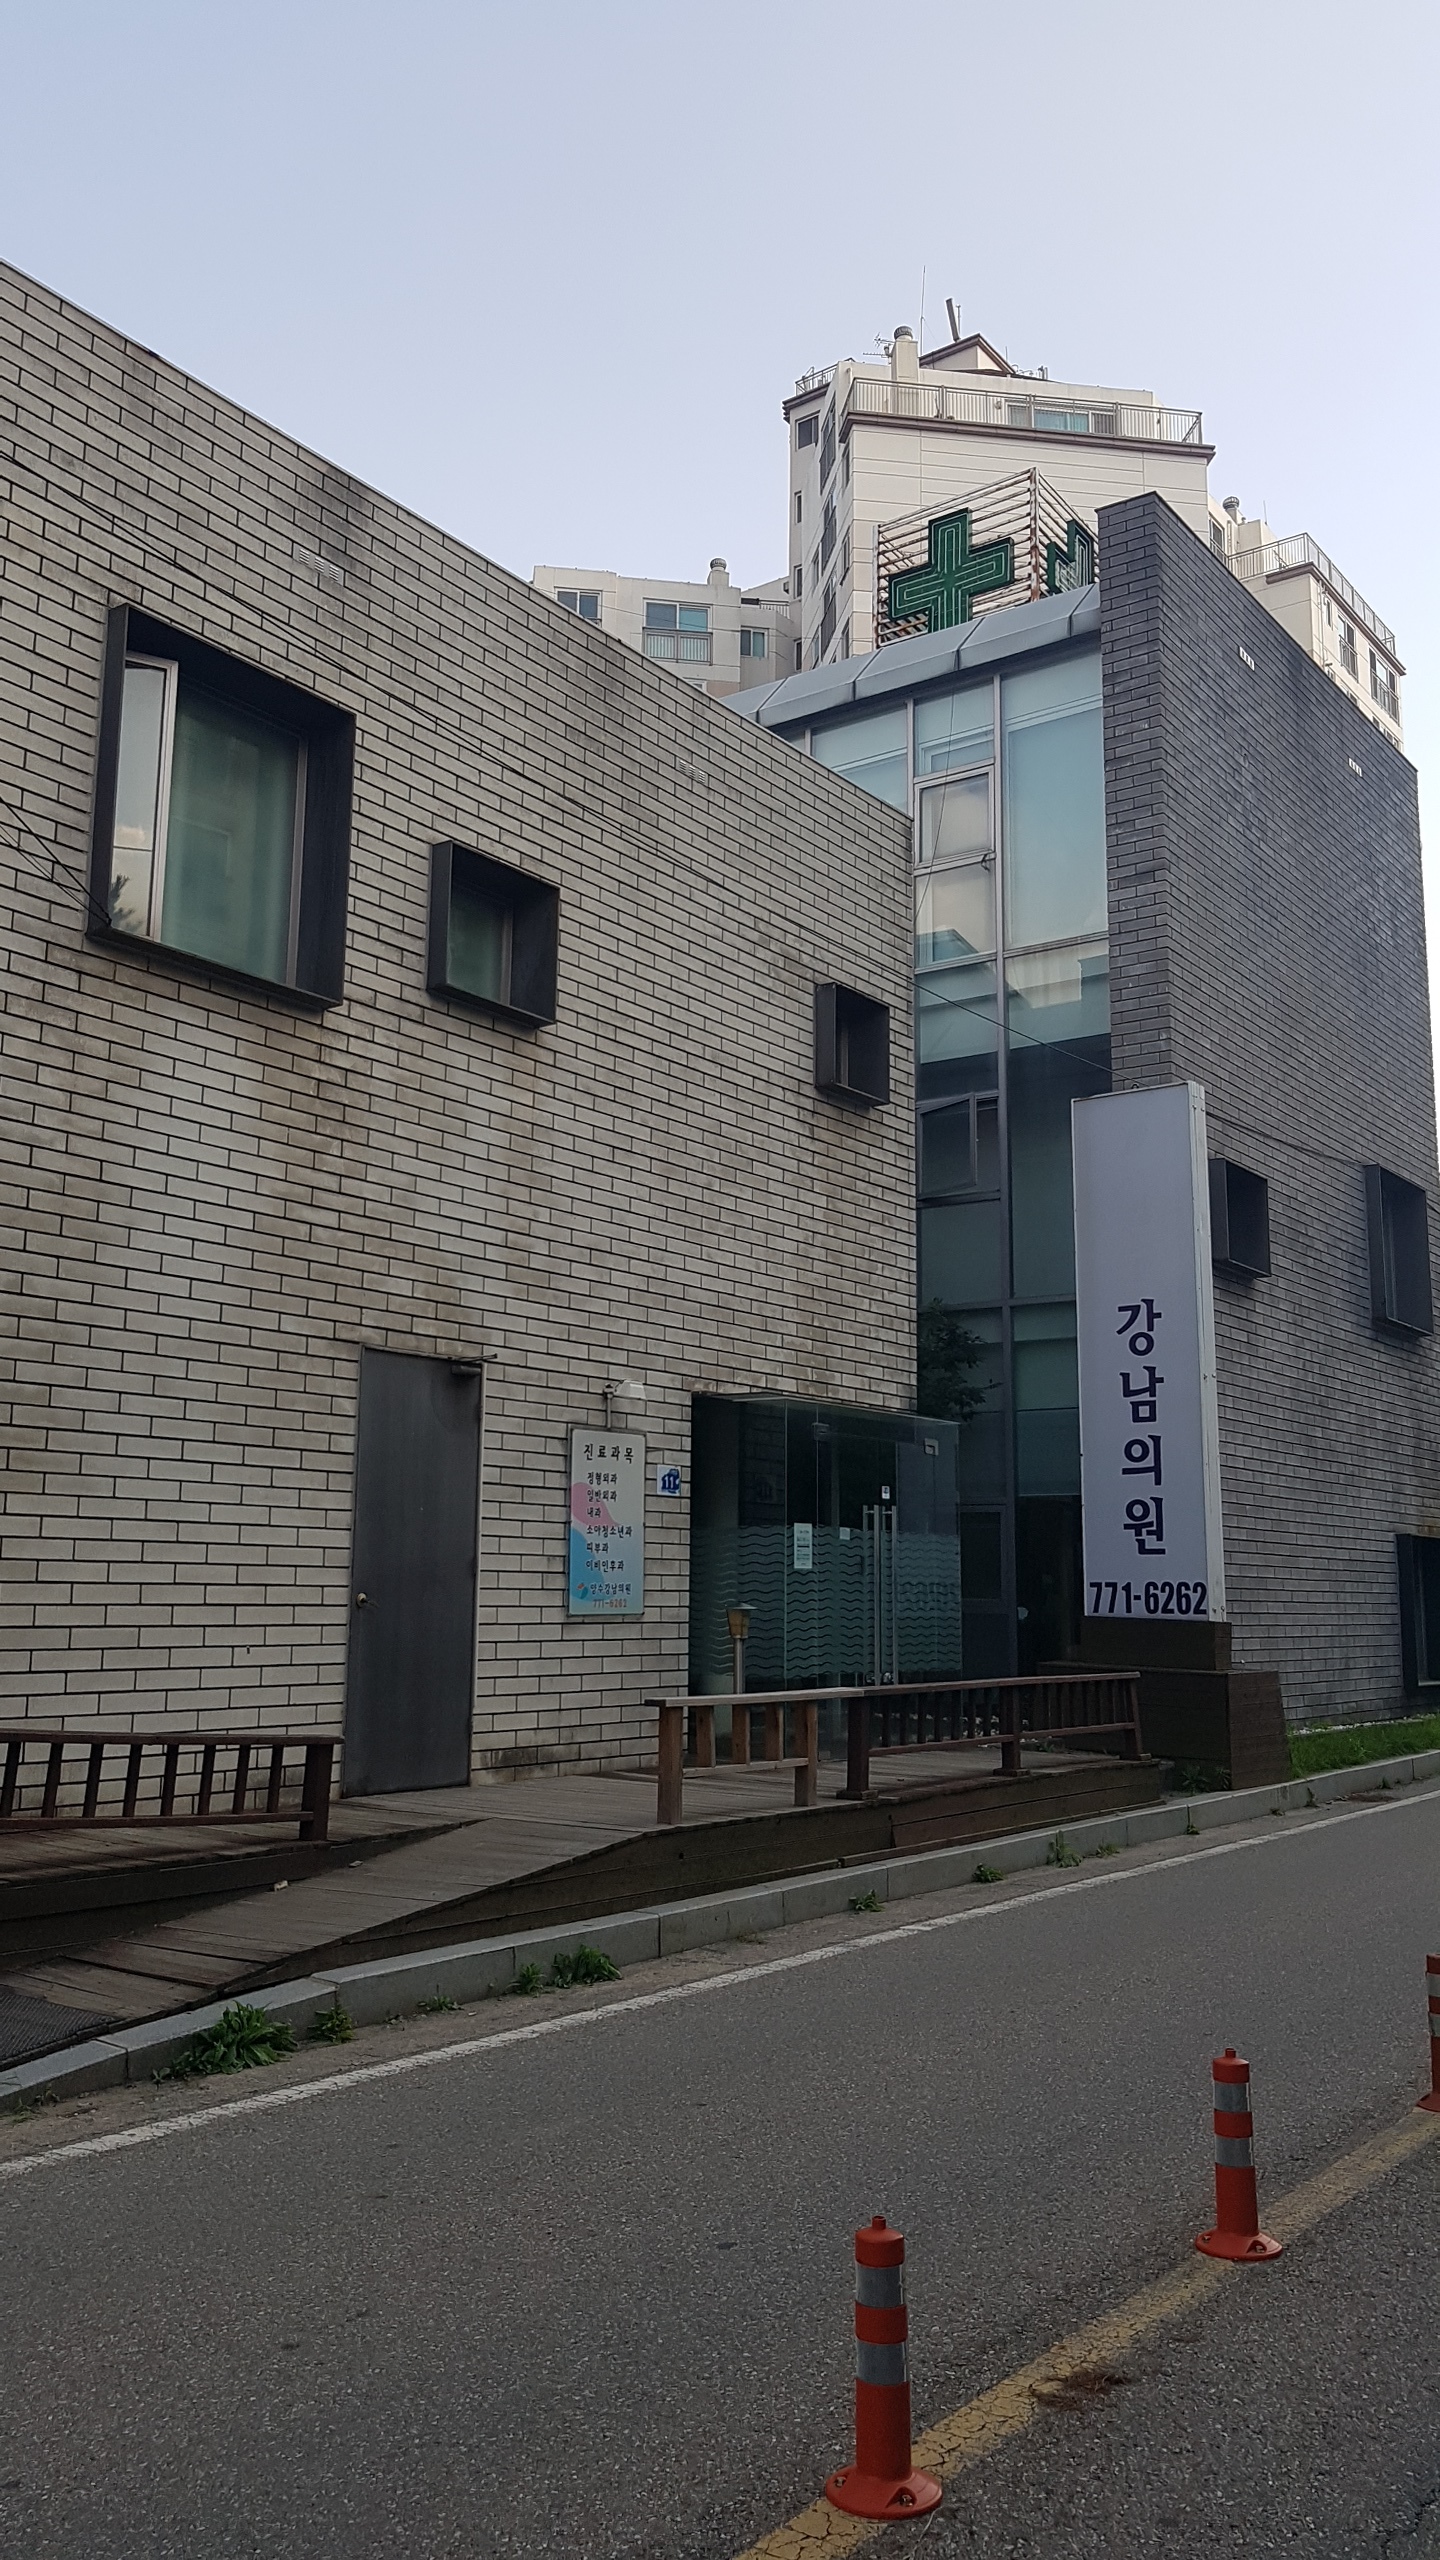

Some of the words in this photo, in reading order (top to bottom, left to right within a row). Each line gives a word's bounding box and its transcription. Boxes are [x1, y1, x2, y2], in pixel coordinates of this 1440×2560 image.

[1116, 1297, 1167, 1556] 강남의원
[587, 1471, 618, 1486] 정형외과
[664, 1475, 674, 1488] 11
[587, 1489, 617, 1503] 일반외과
[587, 1507, 601, 1518] 내과
[586, 1524, 633, 1539] 소아청소년과
[586, 1542, 609, 1554] 피부과
[586, 1559, 625, 1573] 이비인후과
[1089, 1580, 1208, 1615] 771-6262
